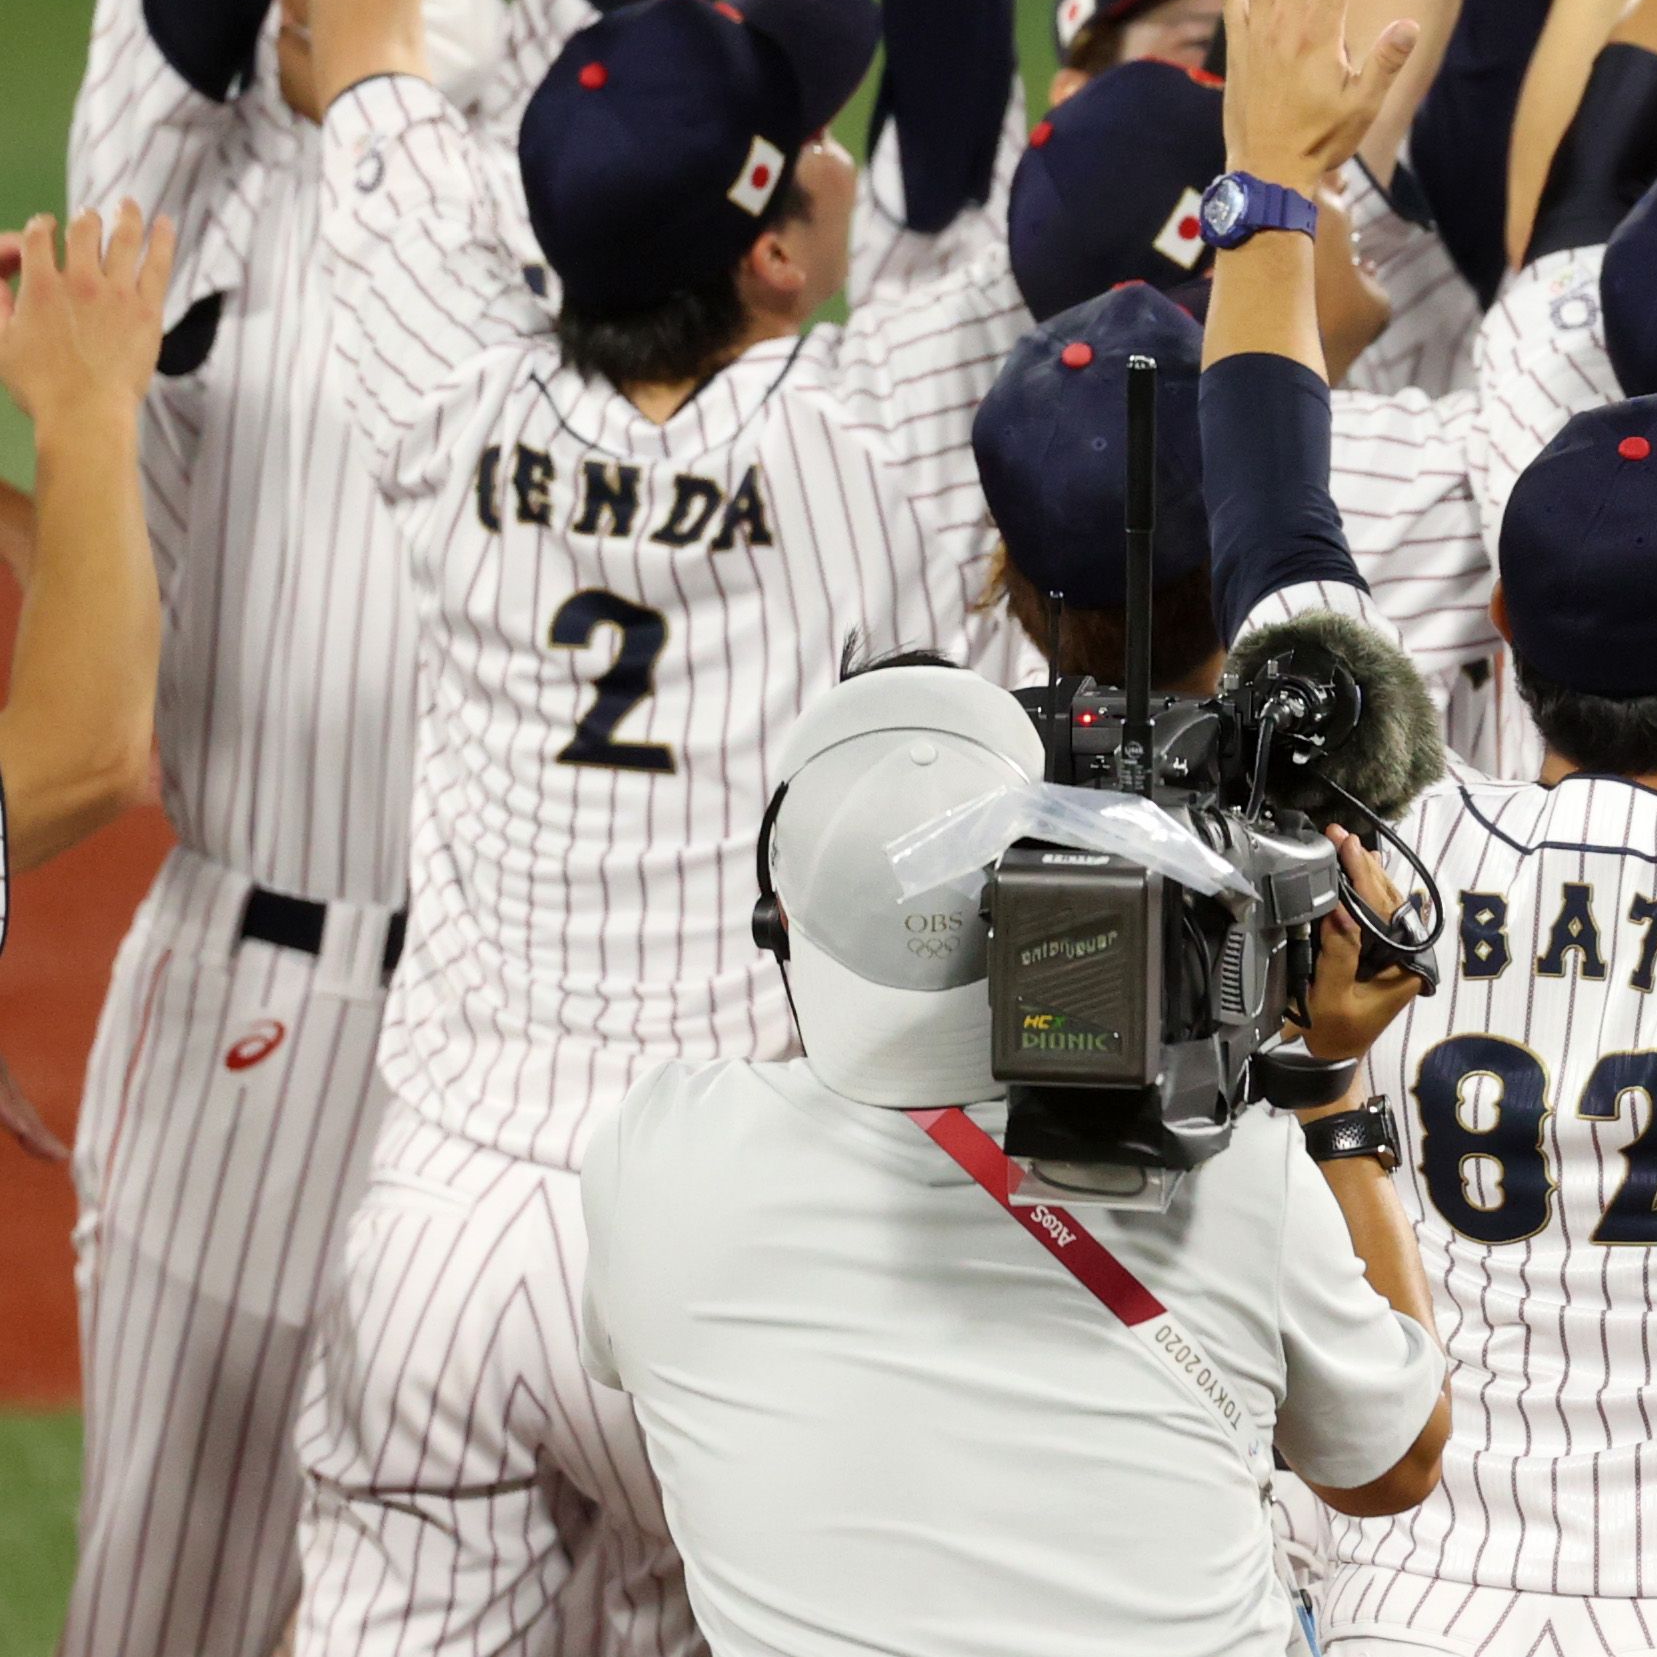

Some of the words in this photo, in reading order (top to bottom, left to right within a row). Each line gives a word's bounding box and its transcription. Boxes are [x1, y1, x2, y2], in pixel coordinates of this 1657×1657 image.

[551, 588, 677, 775] 2
[904, 911, 963, 934] OBS
[1030, 1204, 1077, 1248] Atos
[1155, 1324, 1202, 1374] 2020
[1196, 1367, 1242, 1432] TOKYO
